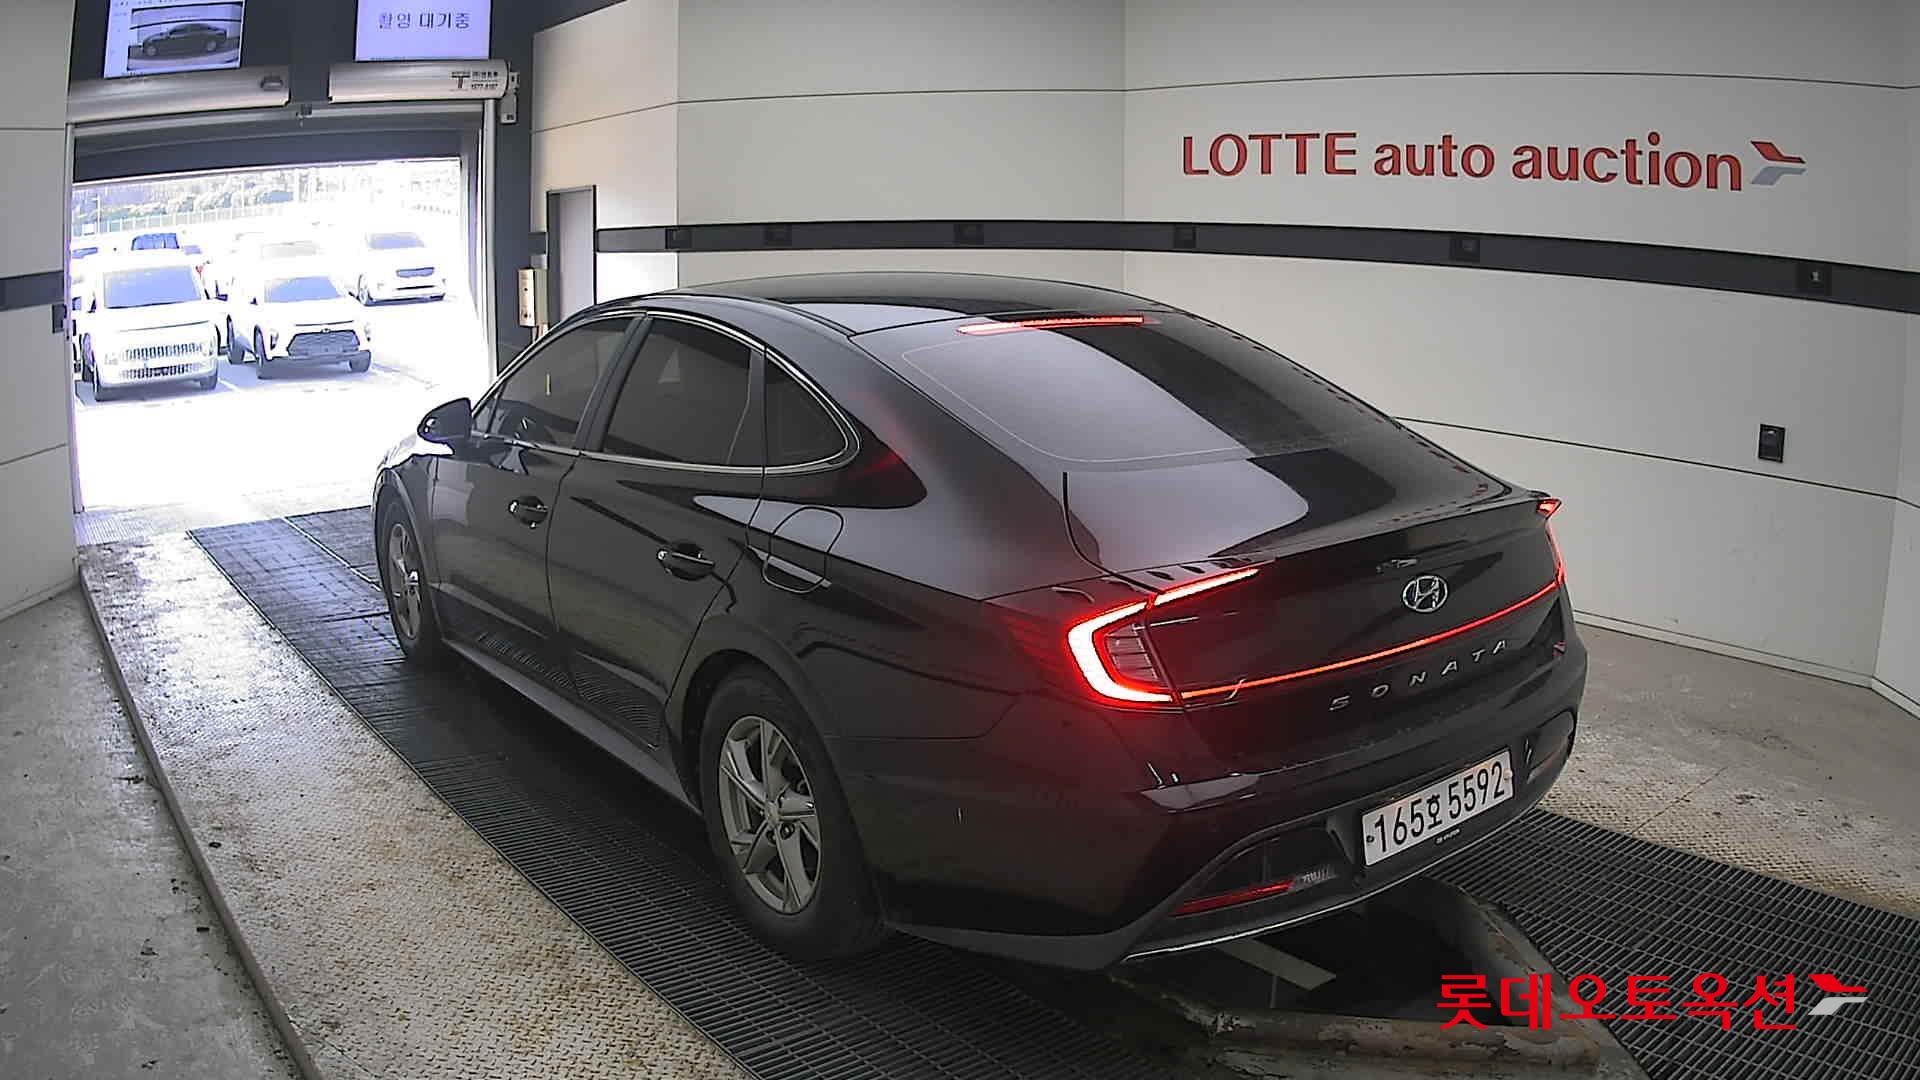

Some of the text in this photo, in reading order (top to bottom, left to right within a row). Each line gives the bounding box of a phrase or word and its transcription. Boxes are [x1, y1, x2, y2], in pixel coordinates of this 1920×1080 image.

[419, 12, 470, 29] 대기중
[1183, 131, 1743, 191] LOTTE auto auction
[1328, 639, 1507, 711] SONATA
[1374, 761, 1505, 853] 165호 5592
